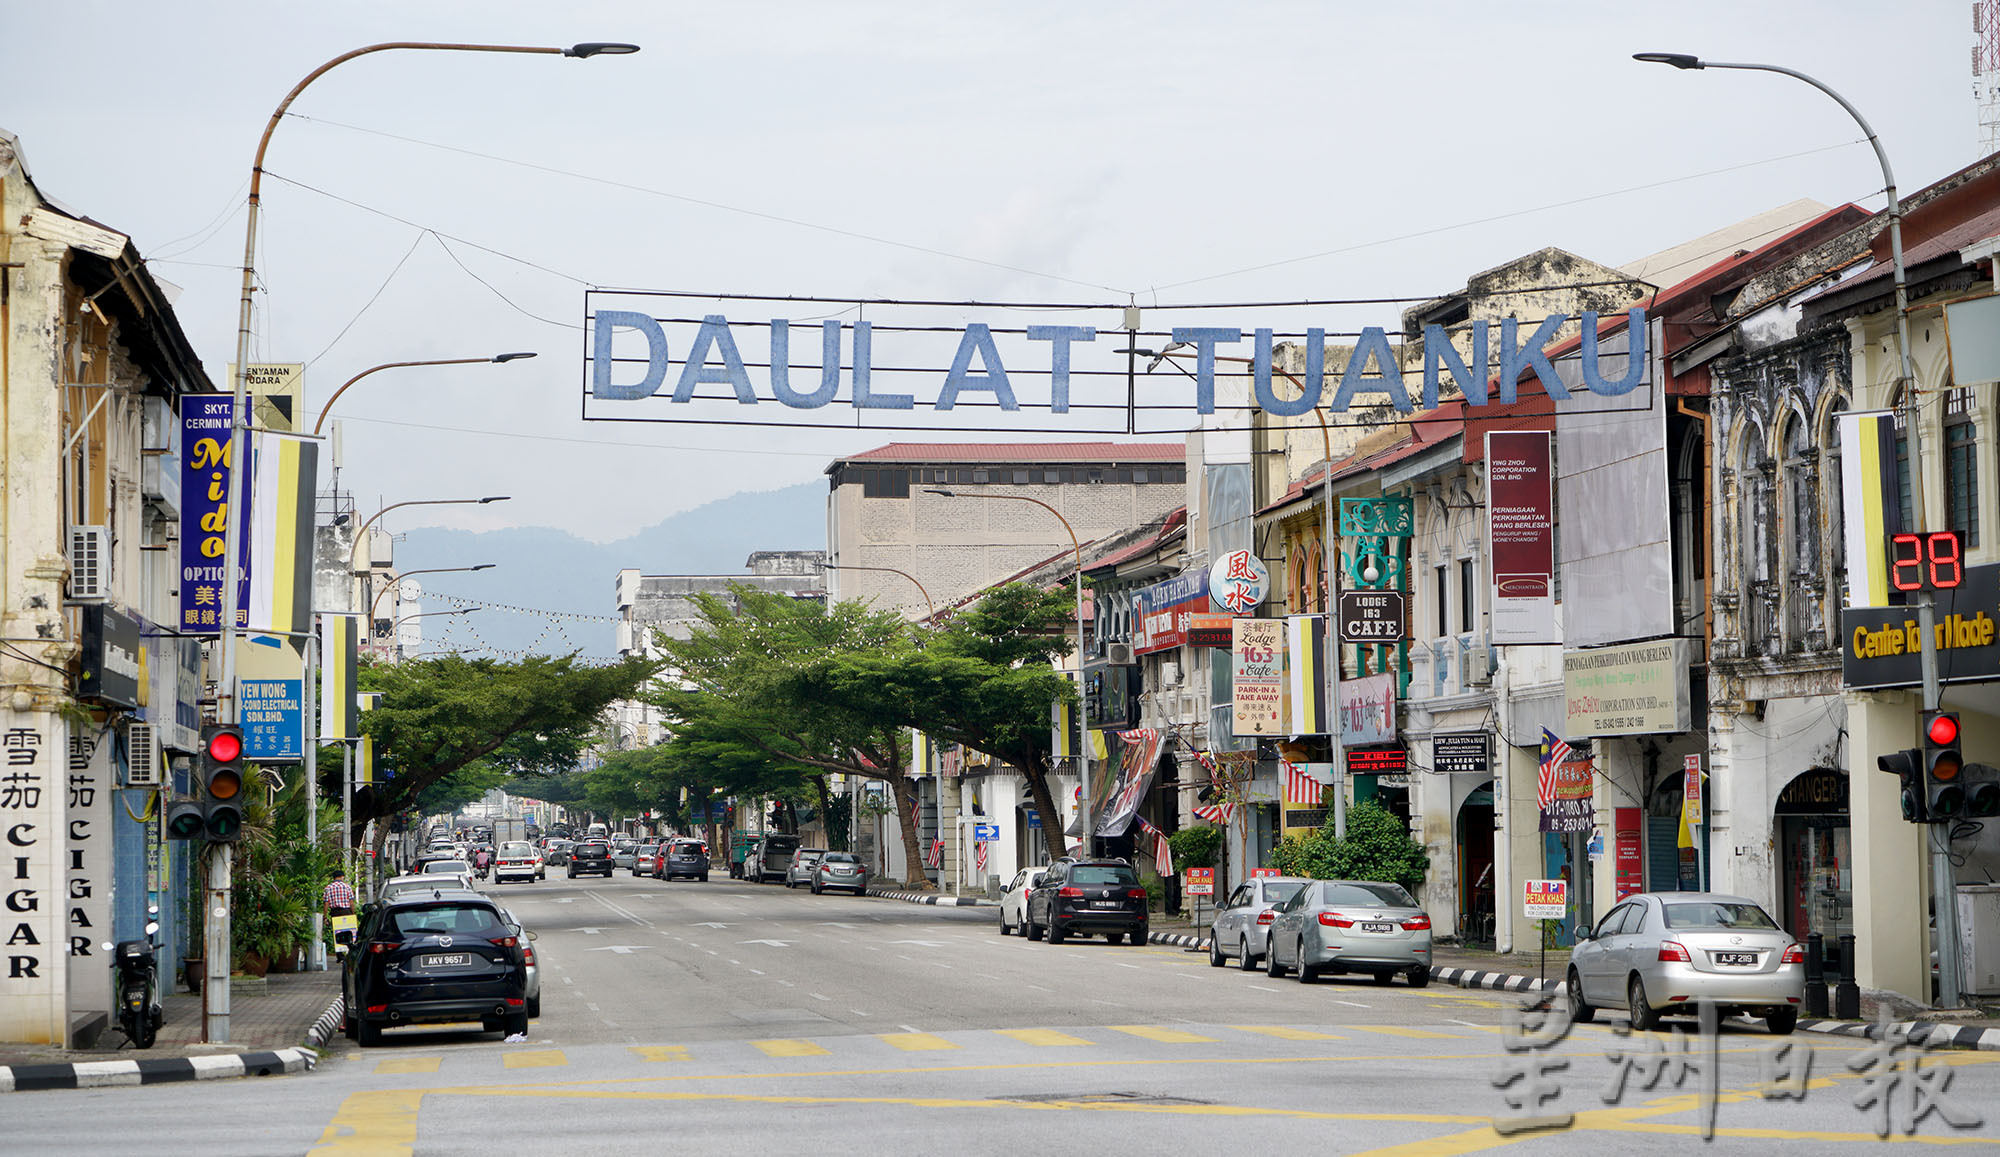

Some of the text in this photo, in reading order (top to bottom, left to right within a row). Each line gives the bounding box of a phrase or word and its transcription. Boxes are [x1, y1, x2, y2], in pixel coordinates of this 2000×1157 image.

[592, 307, 1646, 417] DAULAT TUANKU
[247, 368, 290, 376] ENYAMAN
[204, 404, 231, 414] SKYT.
[186, 419, 221, 429] CERMIN
[1893, 533, 1961, 591] 28
[1225, 549, 1258, 613] 風水
[1356, 597, 1388, 608] LODGE
[1363, 608, 1381, 619] 163
[1347, 620, 1398, 636] CAFE
[1853, 623, 1905, 660] Centre
[1945, 611, 1995, 649] Made
[1240, 632, 1276, 647] Lodge
[1646, 646, 1672, 662] BERLESEN
[1246, 664, 1272, 679] Cafe
[240, 684, 286, 698] YEW WONG
[262, 700, 299, 711] ELECTRICAL
[1600, 698, 1635, 714] CORPORATION
[1351, 697, 1363, 732] 163
[2, 728, 42, 810] 雪茄
[70, 820, 93, 956] CIGAR
[1550, 883, 1558, 892] P
[6, 823, 41, 979] CIGAR
[1526, 893, 1564, 904] PETAK KHAS
[428, 955, 463, 965] AKV 9657
[1721, 954, 1737, 963] AJF
